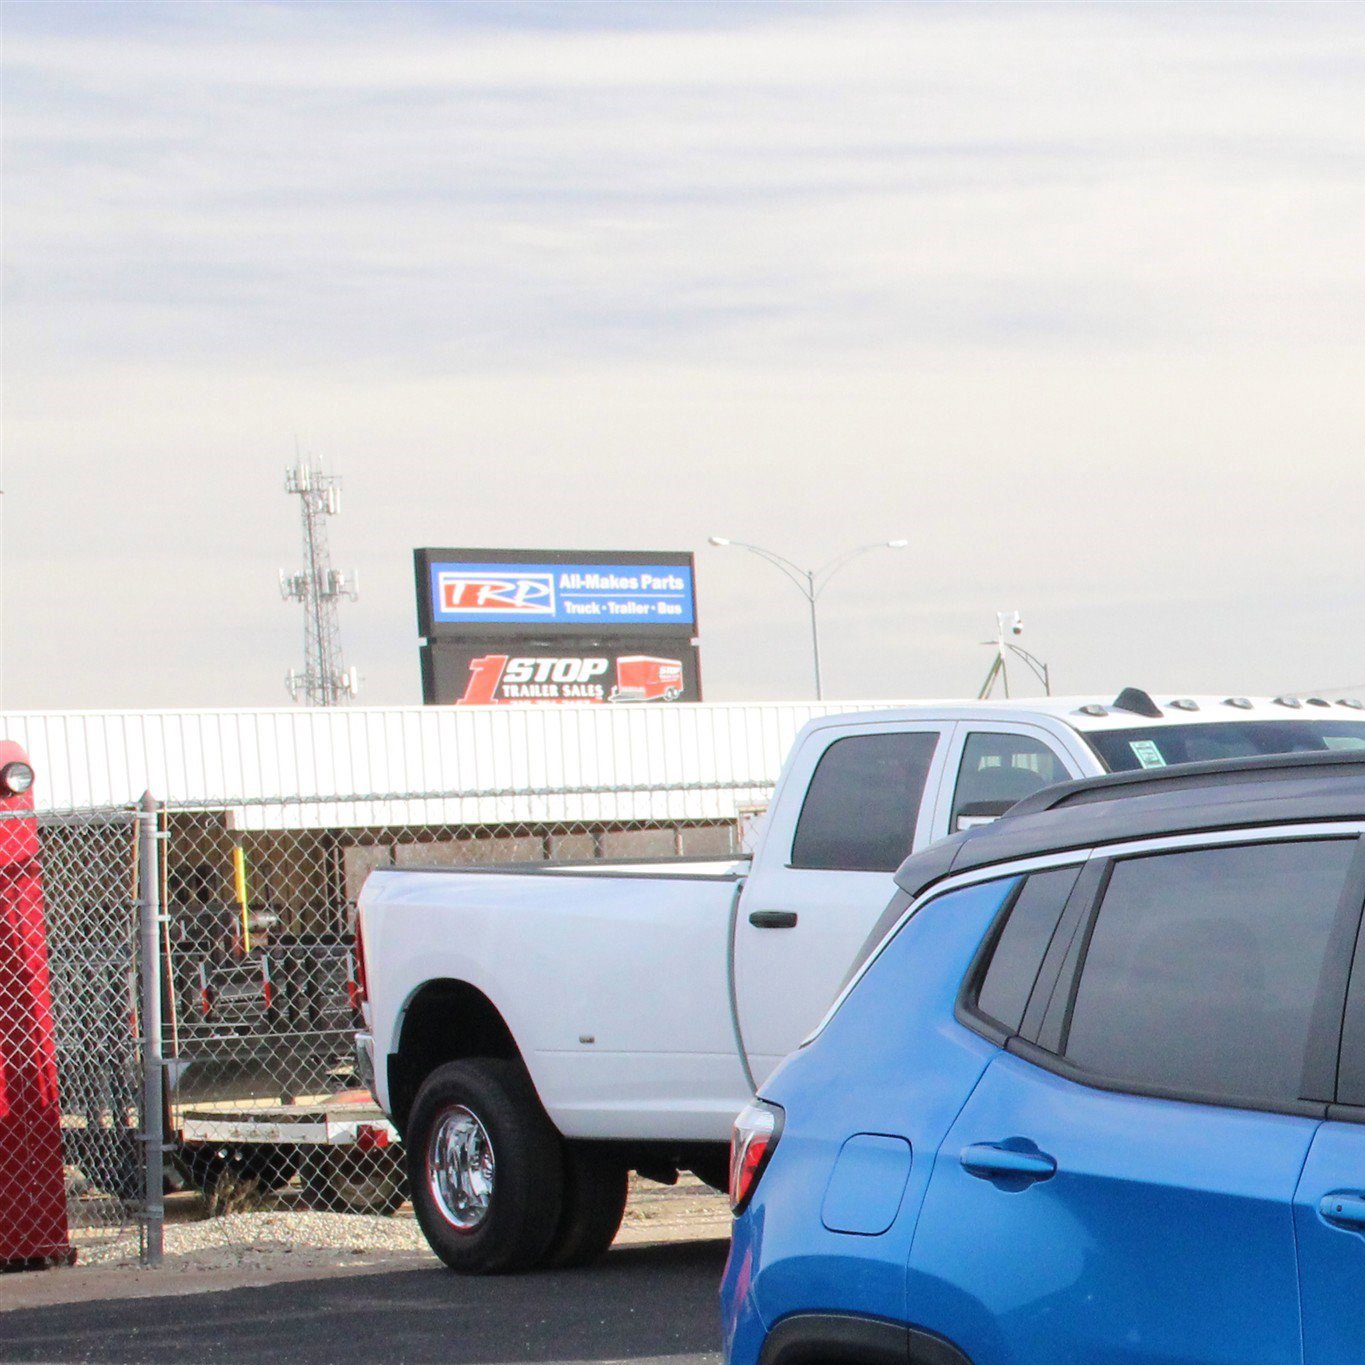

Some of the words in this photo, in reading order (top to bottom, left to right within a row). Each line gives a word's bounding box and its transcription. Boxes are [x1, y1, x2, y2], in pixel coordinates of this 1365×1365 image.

[560, 573, 639, 590] All-Makes
[641, 573, 685, 590] Parts
[443, 579, 550, 607] TRP
[564, 601, 601, 615] Truck
[607, 601, 650, 615] Trailer
[657, 601, 683, 615] Bus
[456, 655, 508, 705] 1
[502, 657, 609, 683] STOP
[502, 684, 559, 698] TRAILER
[561, 683, 605, 698] SALES
